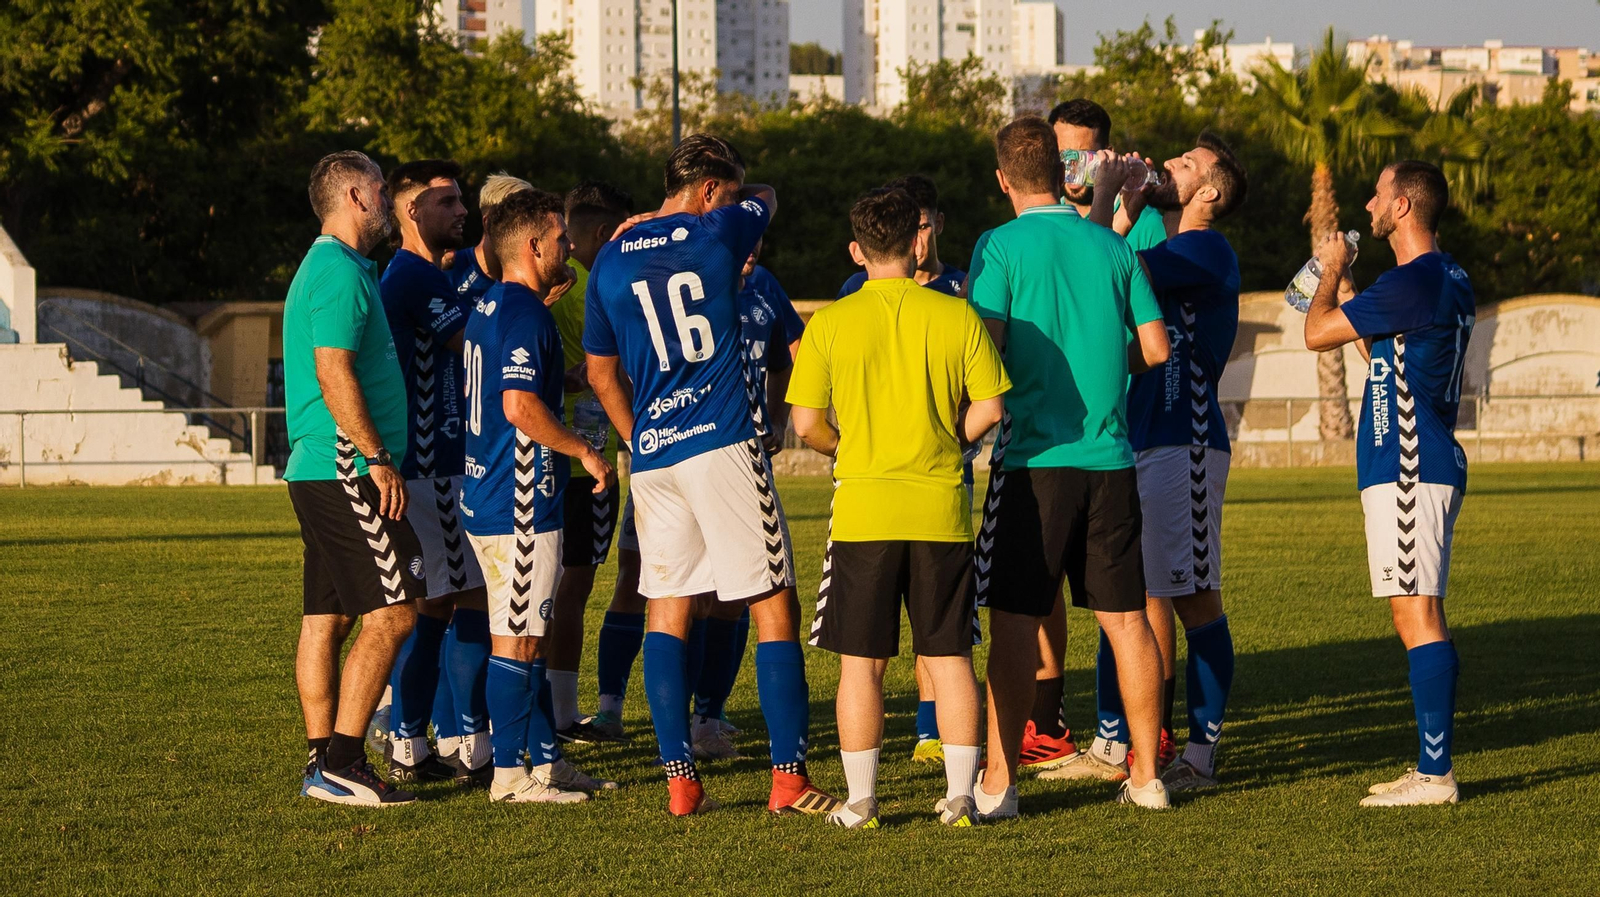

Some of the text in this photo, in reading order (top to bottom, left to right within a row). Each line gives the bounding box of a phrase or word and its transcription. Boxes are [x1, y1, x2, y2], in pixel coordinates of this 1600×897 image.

[621, 236, 668, 253] indeso
[430, 306, 460, 329] SUZUKI
[631, 271, 715, 372] 16
[1173, 351, 1180, 363] LA
[502, 365, 535, 376] SUZUKI
[1164, 361, 1172, 412] TELIGENTE
[444, 403, 451, 415] LA
[1372, 384, 1383, 447] INTELIGENTE
[1380, 384, 1389, 434] LA TIENDA
[542, 460, 549, 472] LA
